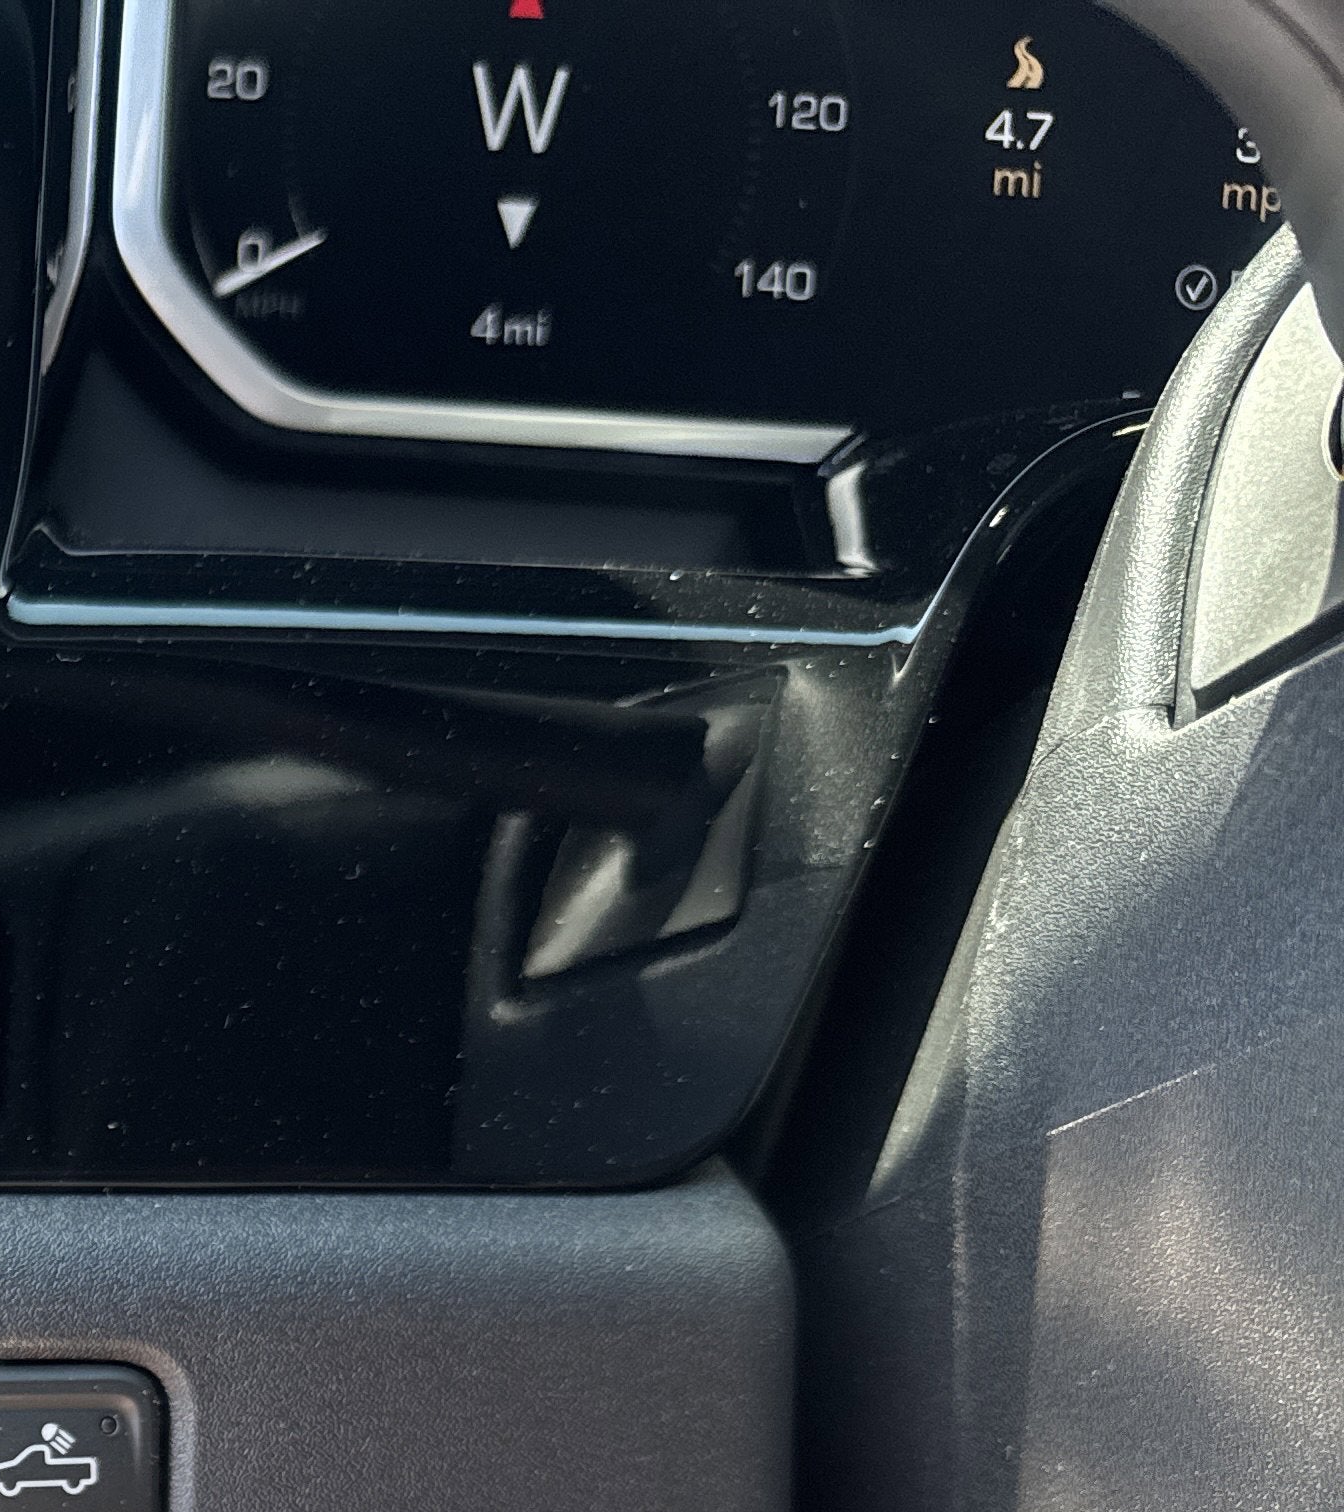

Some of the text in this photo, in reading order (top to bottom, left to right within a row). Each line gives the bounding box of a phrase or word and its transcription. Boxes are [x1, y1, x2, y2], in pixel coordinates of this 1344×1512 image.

[206, 57, 269, 102] 20
[472, 61, 572, 154] W
[767, 89, 849, 133] 120
[984, 109, 1055, 152] 4.7
[993, 161, 1043, 199] mi
[1221, 181, 1282, 223] mp
[734, 259, 817, 302] 140
